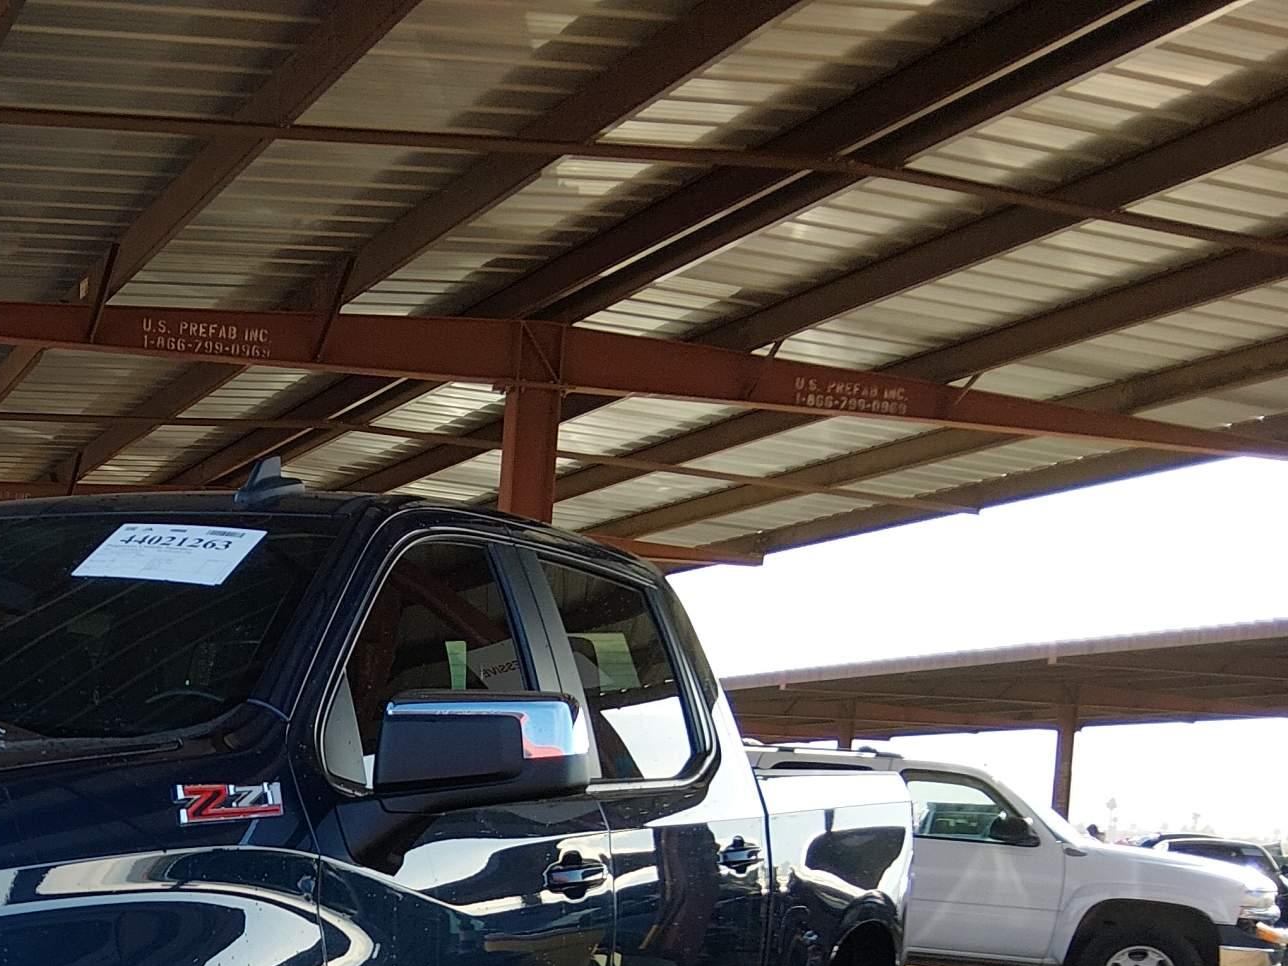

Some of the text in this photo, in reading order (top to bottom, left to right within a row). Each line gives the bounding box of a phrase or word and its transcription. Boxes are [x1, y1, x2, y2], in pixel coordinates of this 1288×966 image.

[142, 317, 273, 344] U.S. PREFAB INC.
[827, 381, 878, 398] PREFAB
[120, 534, 233, 551] 44021263
[176, 782, 284, 826] Z71
